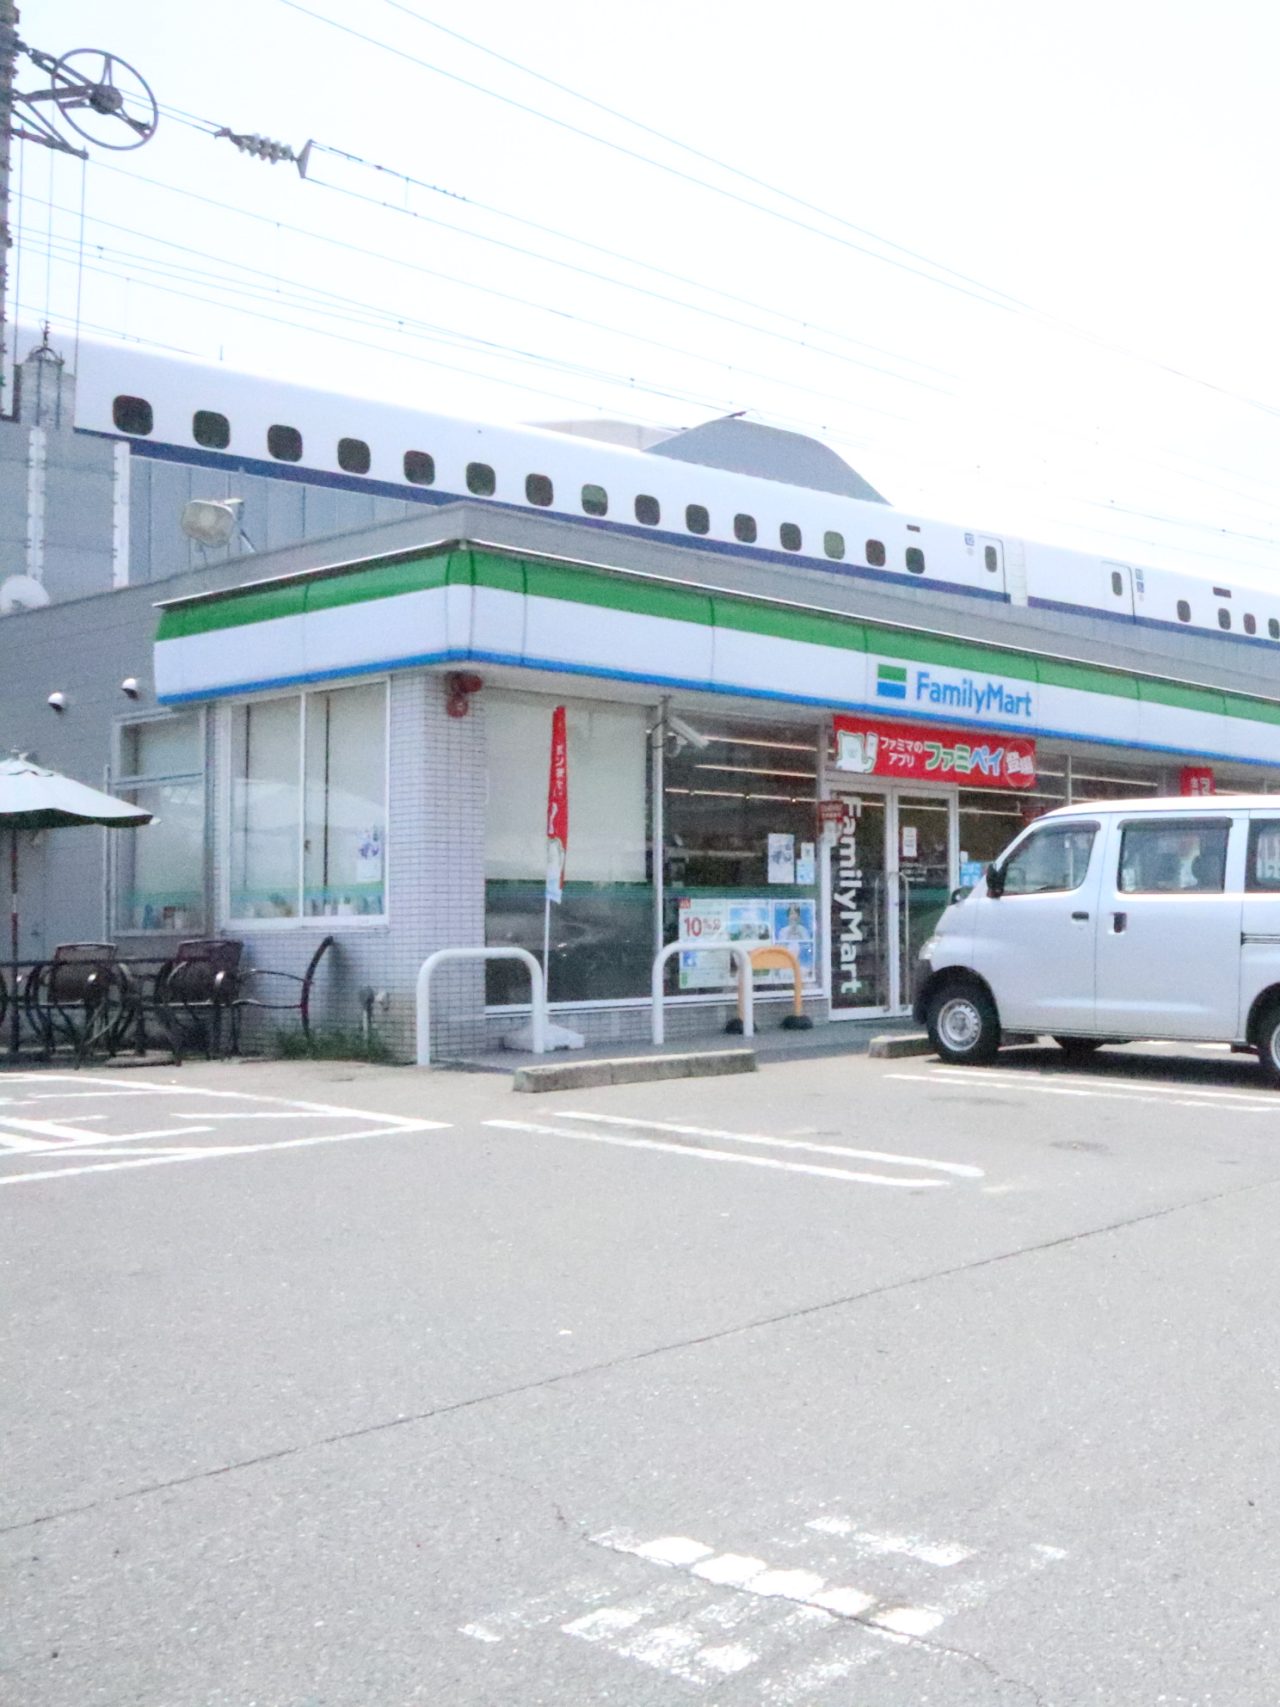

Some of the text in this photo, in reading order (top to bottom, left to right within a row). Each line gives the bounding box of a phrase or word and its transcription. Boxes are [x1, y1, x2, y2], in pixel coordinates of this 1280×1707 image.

[916, 670, 1032, 717] FamilyMart
[879, 736, 924, 754] ファミマの
[888, 752, 916, 768] アプリ
[923, 740, 1005, 777] ファミペイ
[834, 796, 864, 994] FamilyMart
